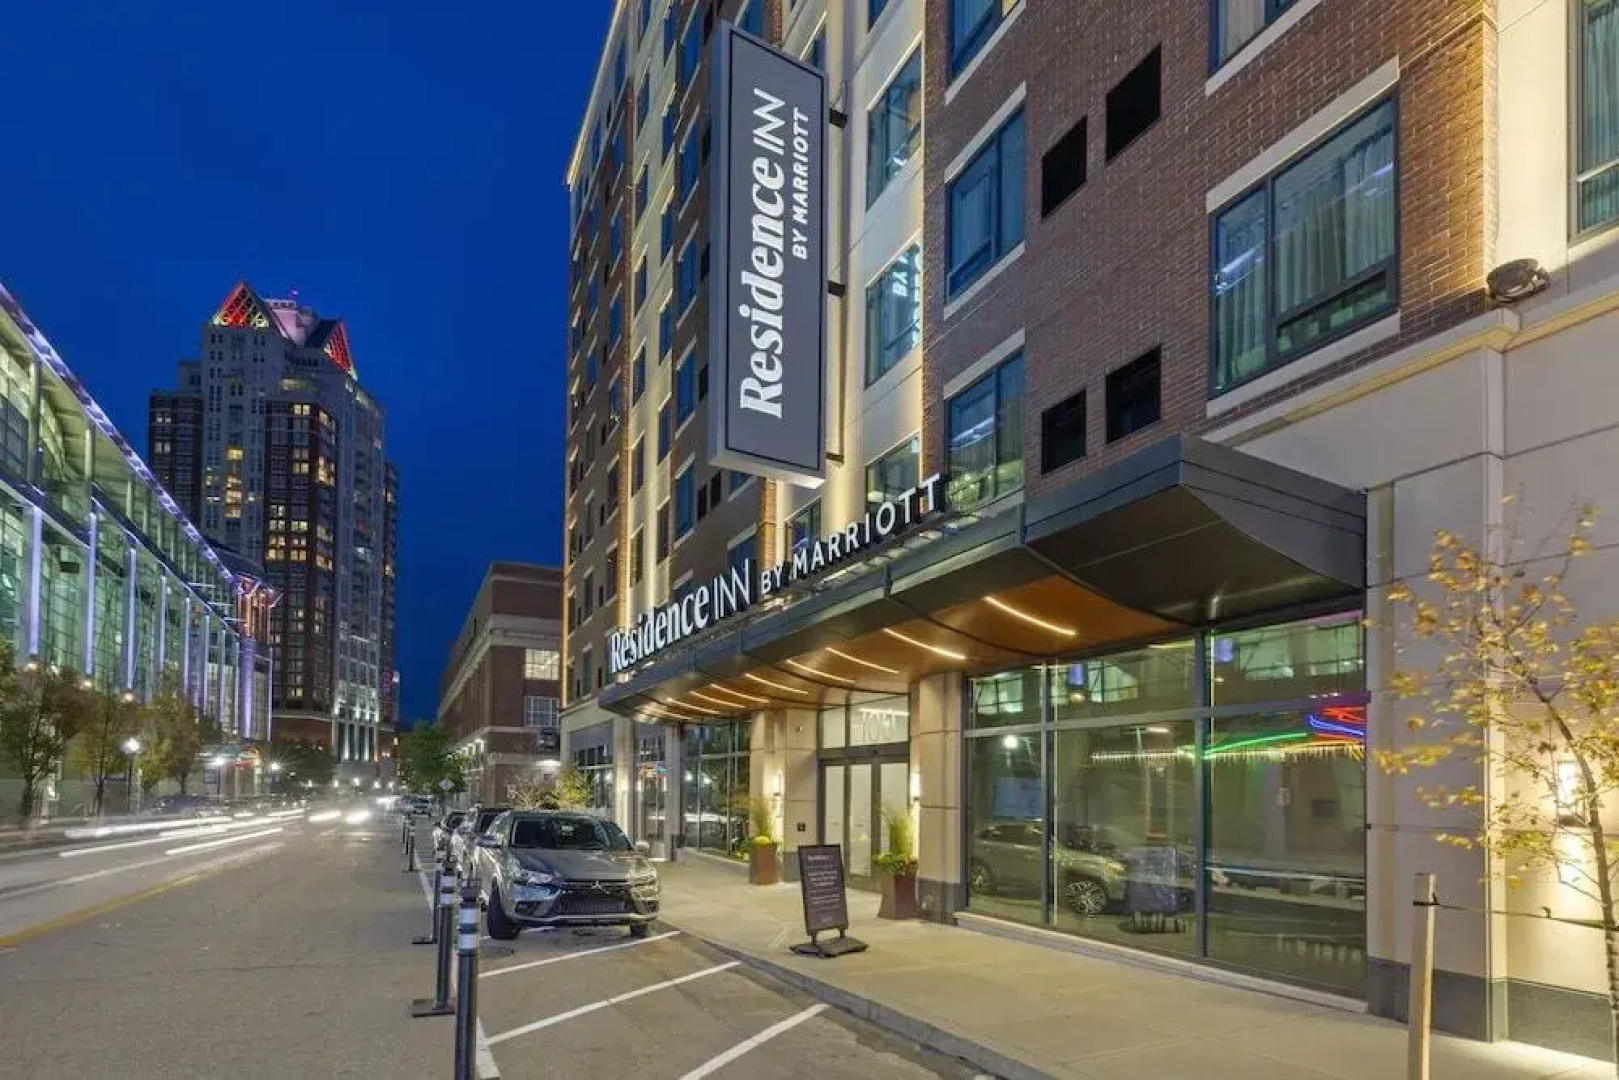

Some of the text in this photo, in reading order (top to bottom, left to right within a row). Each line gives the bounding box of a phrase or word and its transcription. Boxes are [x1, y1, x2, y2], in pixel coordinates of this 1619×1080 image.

[792, 107, 810, 260] BY MARRIOTT
[739, 88, 787, 419] Residence INN
[761, 473, 942, 595] BY MARRIOTT
[610, 558, 751, 673] Residence INN
